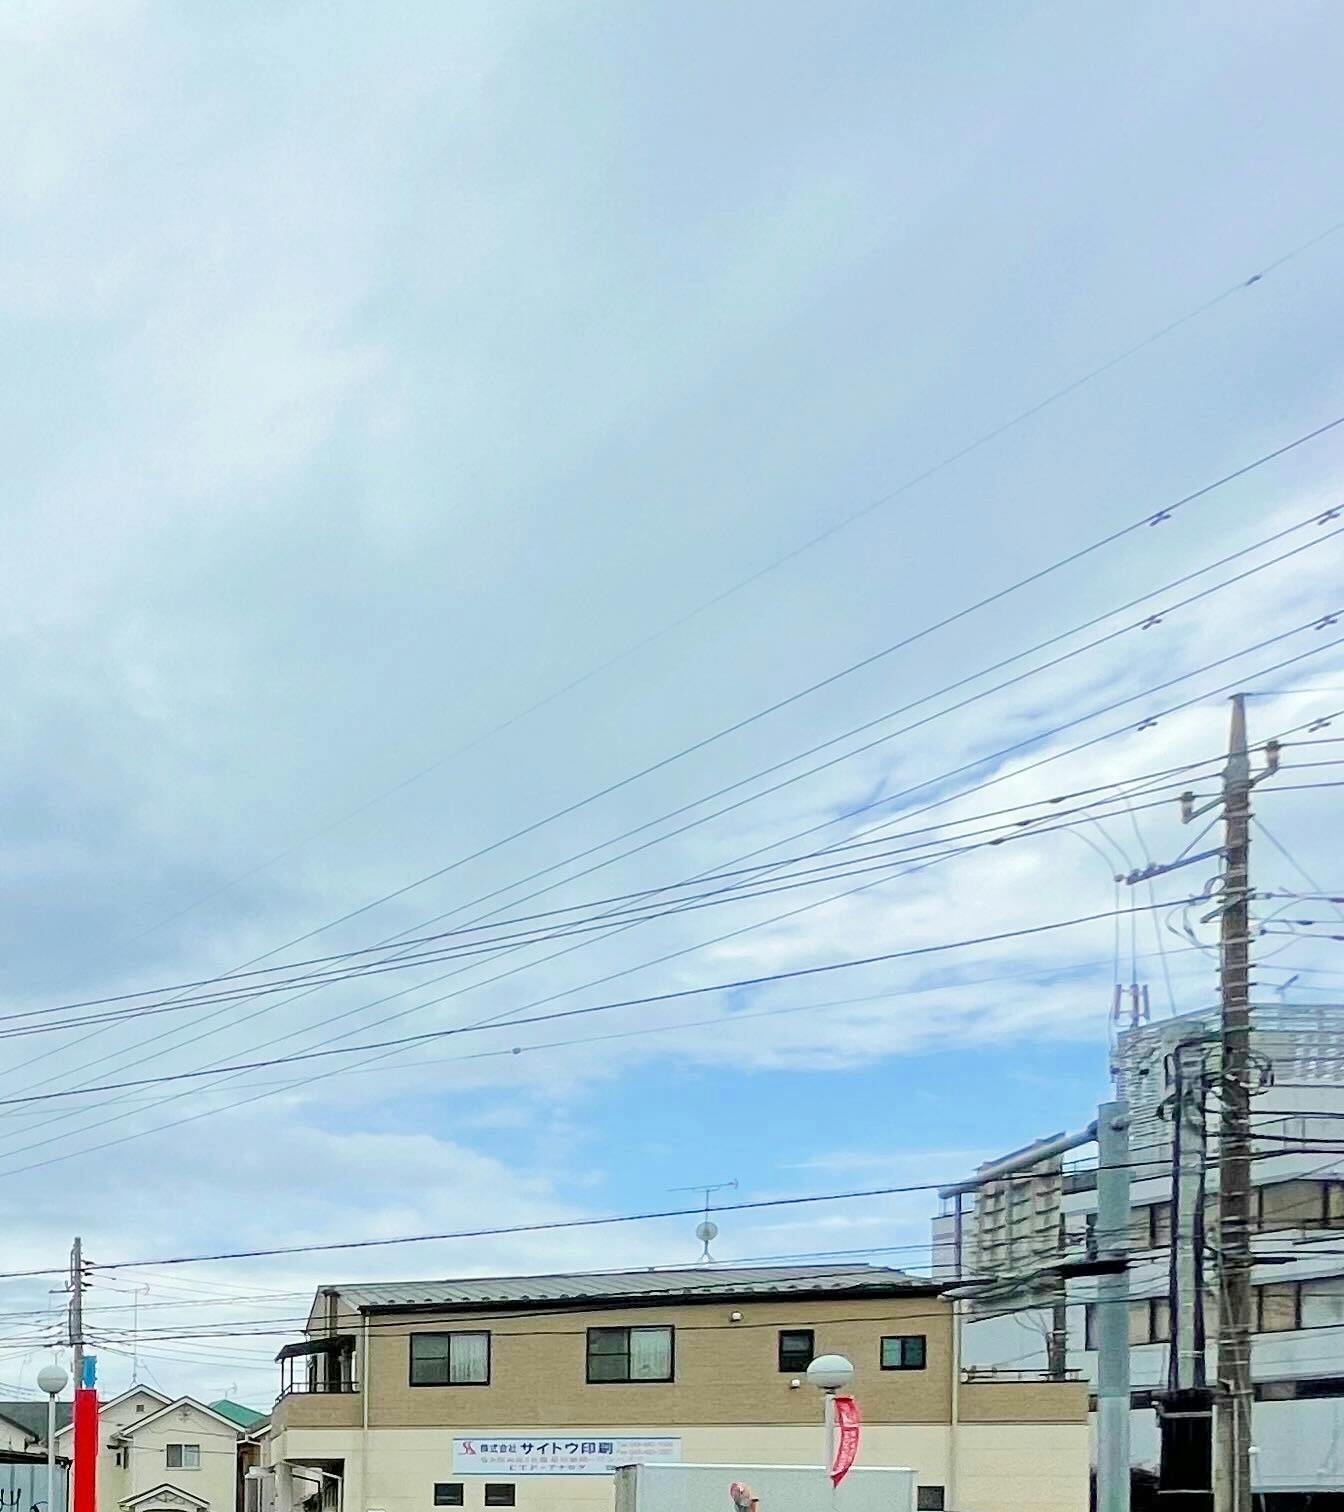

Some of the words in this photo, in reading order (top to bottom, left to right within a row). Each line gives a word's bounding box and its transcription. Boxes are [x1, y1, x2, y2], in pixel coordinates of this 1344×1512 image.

[520, 1441, 614, 1455] サイトウ印刷
